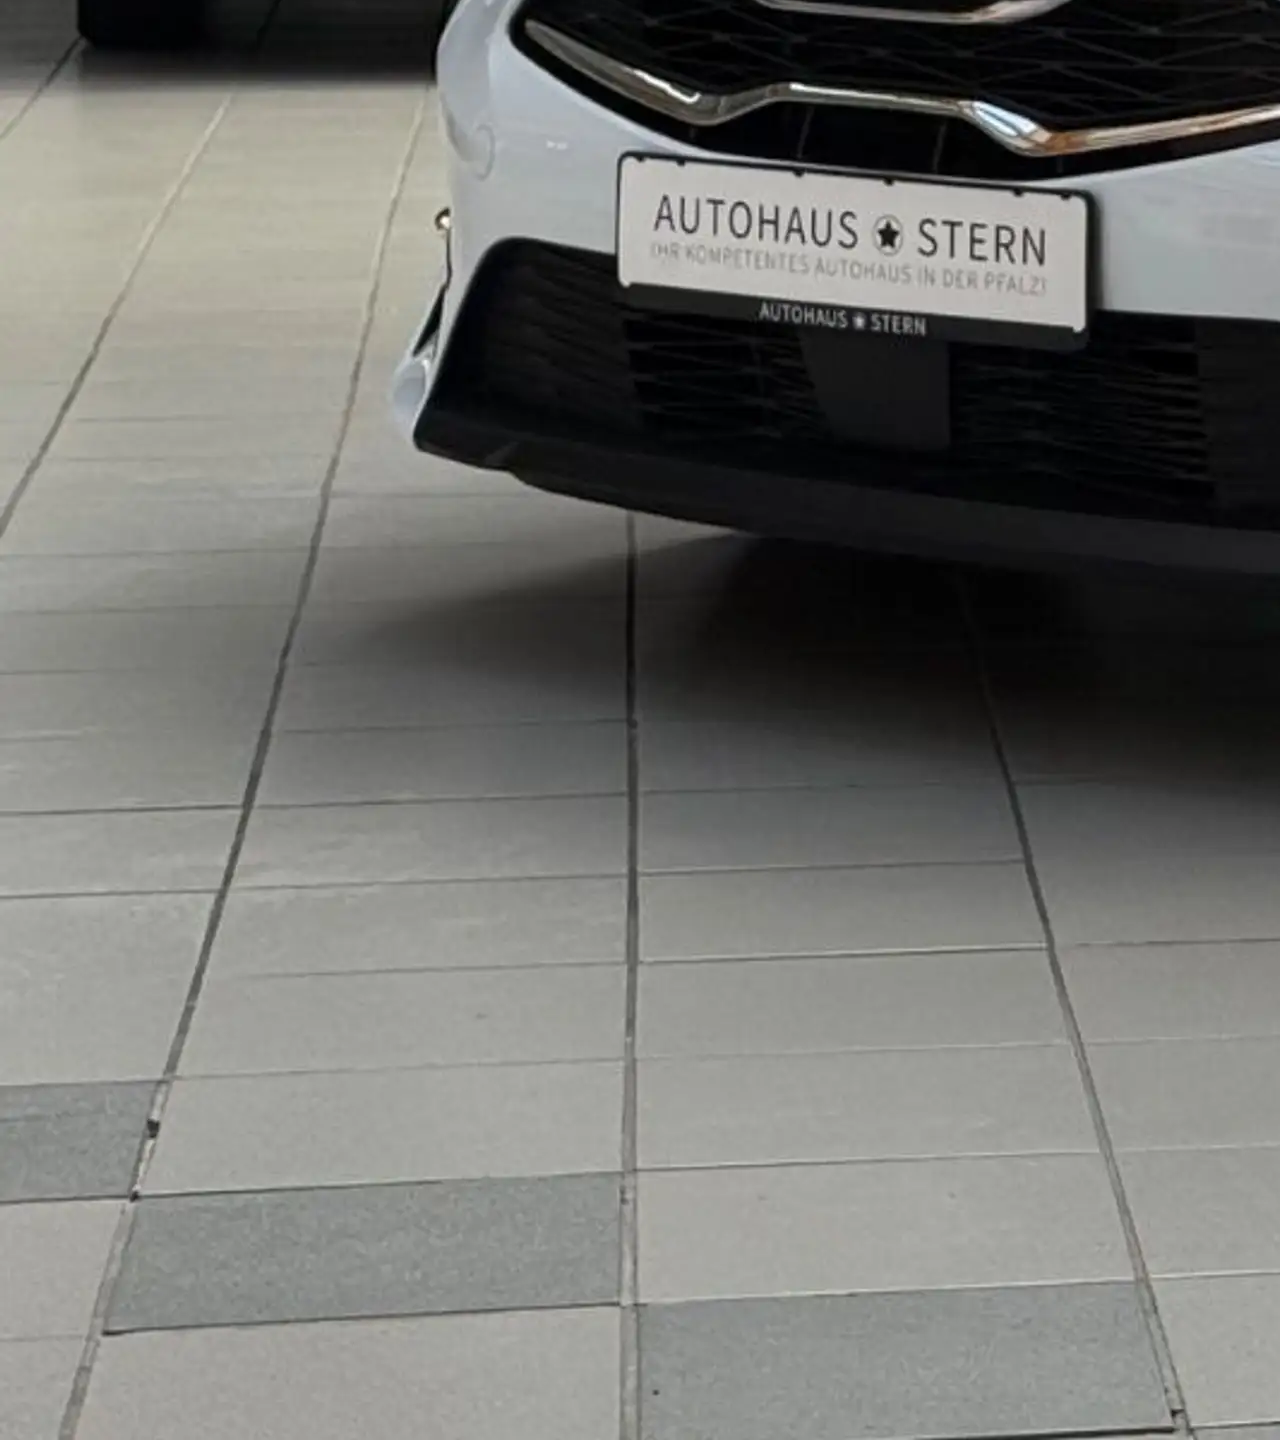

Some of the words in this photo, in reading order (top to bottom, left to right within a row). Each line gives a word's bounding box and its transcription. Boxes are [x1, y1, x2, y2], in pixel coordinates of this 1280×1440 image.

[654, 194, 859, 249] AUTOHAUS
[917, 218, 1046, 266] STERN
[652, 242, 680, 260] IHR
[685, 245, 810, 275] KOMPETENTES
[814, 258, 912, 285] AUTOHAUS
[917, 266, 936, 287] IN
[942, 269, 979, 292] DER
[758, 301, 849, 329] AUTOHAUS
[870, 312, 928, 337] STERN
